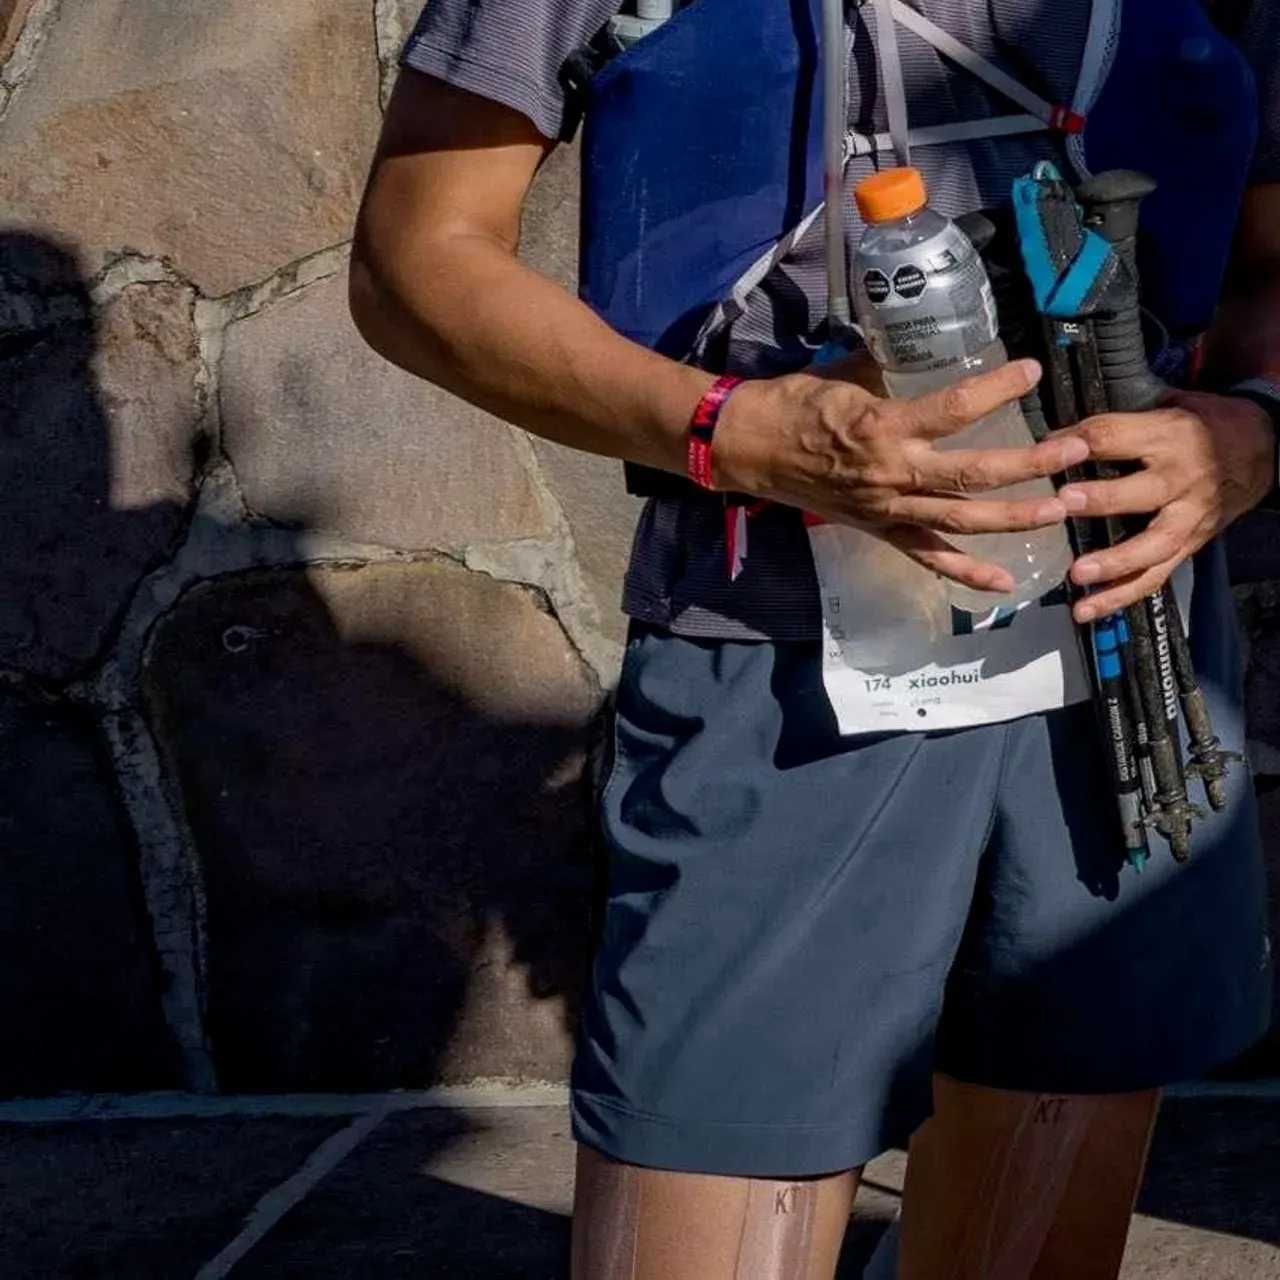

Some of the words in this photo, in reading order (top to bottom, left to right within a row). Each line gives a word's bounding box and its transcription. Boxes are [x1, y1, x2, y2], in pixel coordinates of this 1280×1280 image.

[864, 677, 892, 692] 174
[908, 670, 980, 690] xiaohui
[775, 1186, 801, 1215] KT
